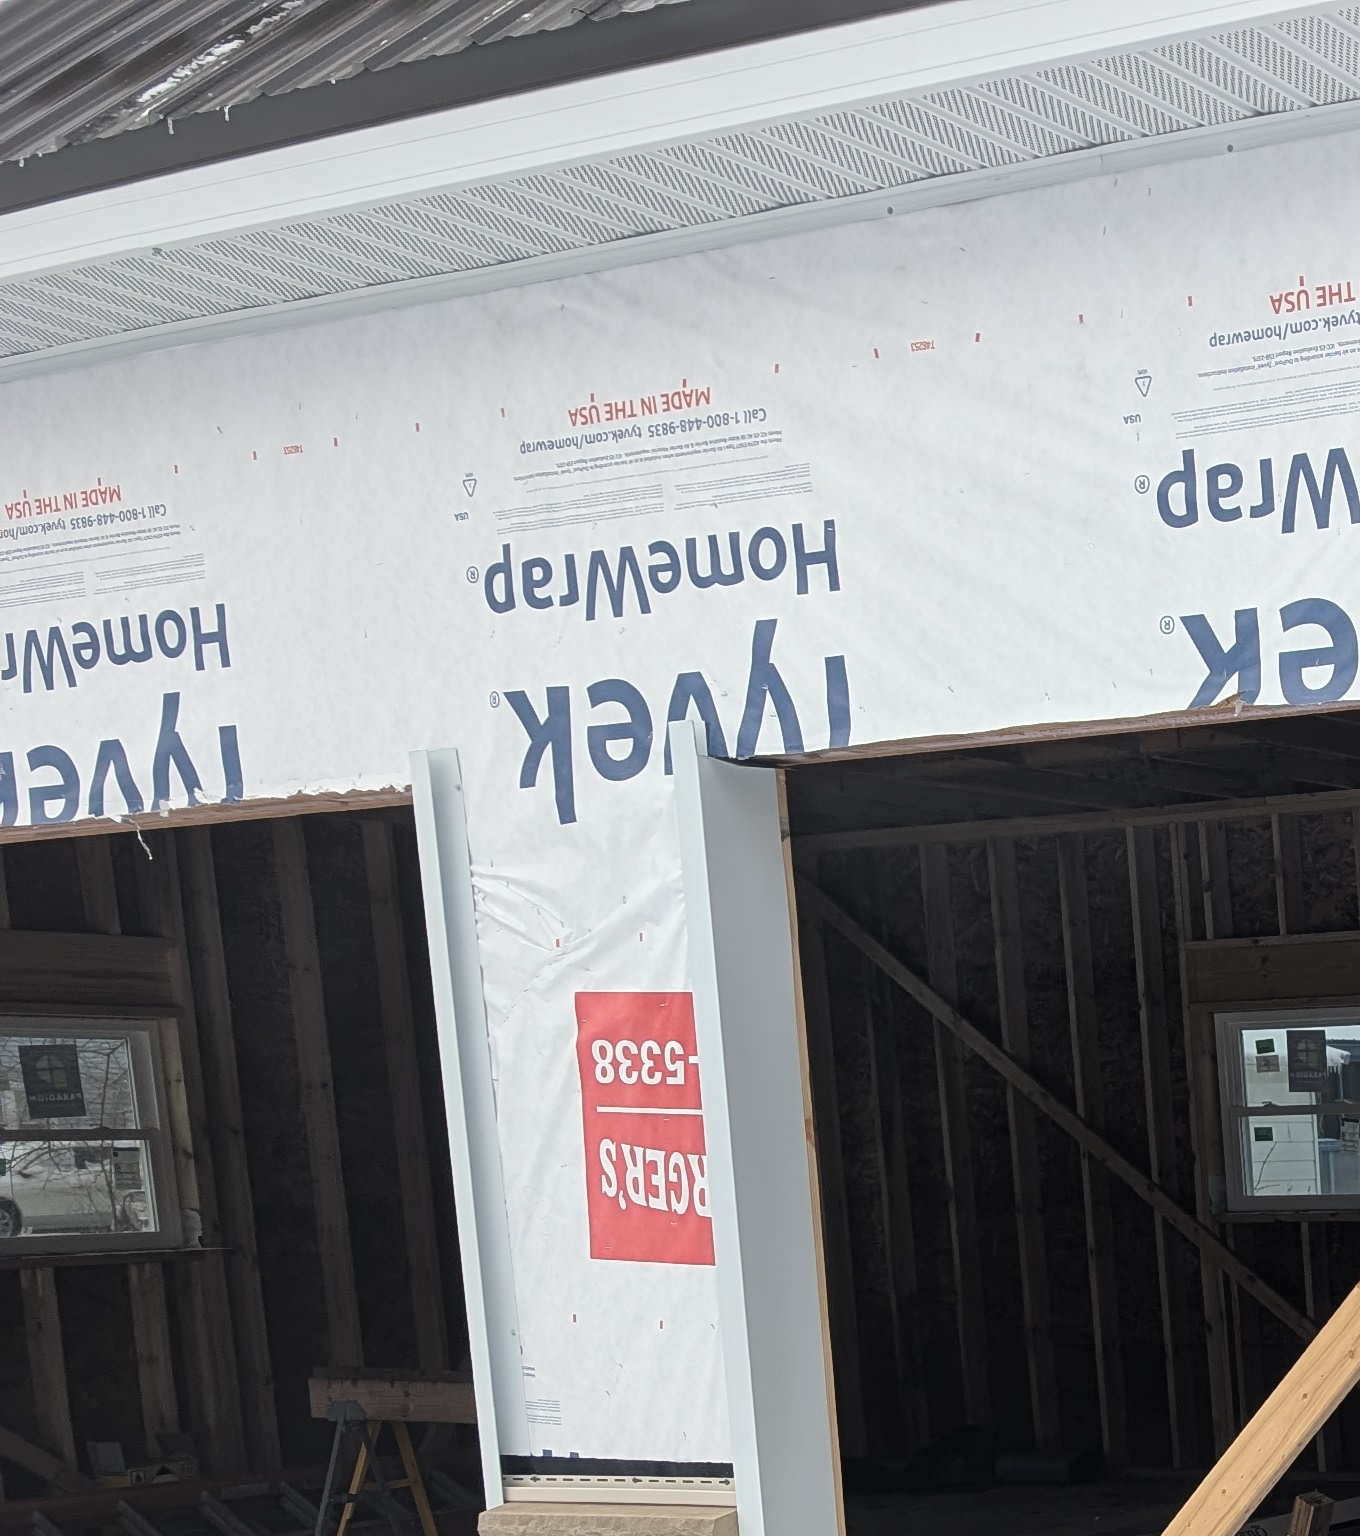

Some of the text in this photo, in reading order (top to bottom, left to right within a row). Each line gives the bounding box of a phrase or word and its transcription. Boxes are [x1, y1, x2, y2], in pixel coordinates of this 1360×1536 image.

[1268, 289, 1311, 315] USA
[1316, 282, 1356, 308] THE
[909, 338, 936, 352] T46253
[568, 387, 712, 427] MADE IN THE USA
[1122, 414, 1142, 425] USA
[520, 408, 767, 455] Call 1-800-448-9835 tyvek.com/homewrap
[3, 485, 122, 520] MADE IN THE USA
[147, 504, 167, 517] Call
